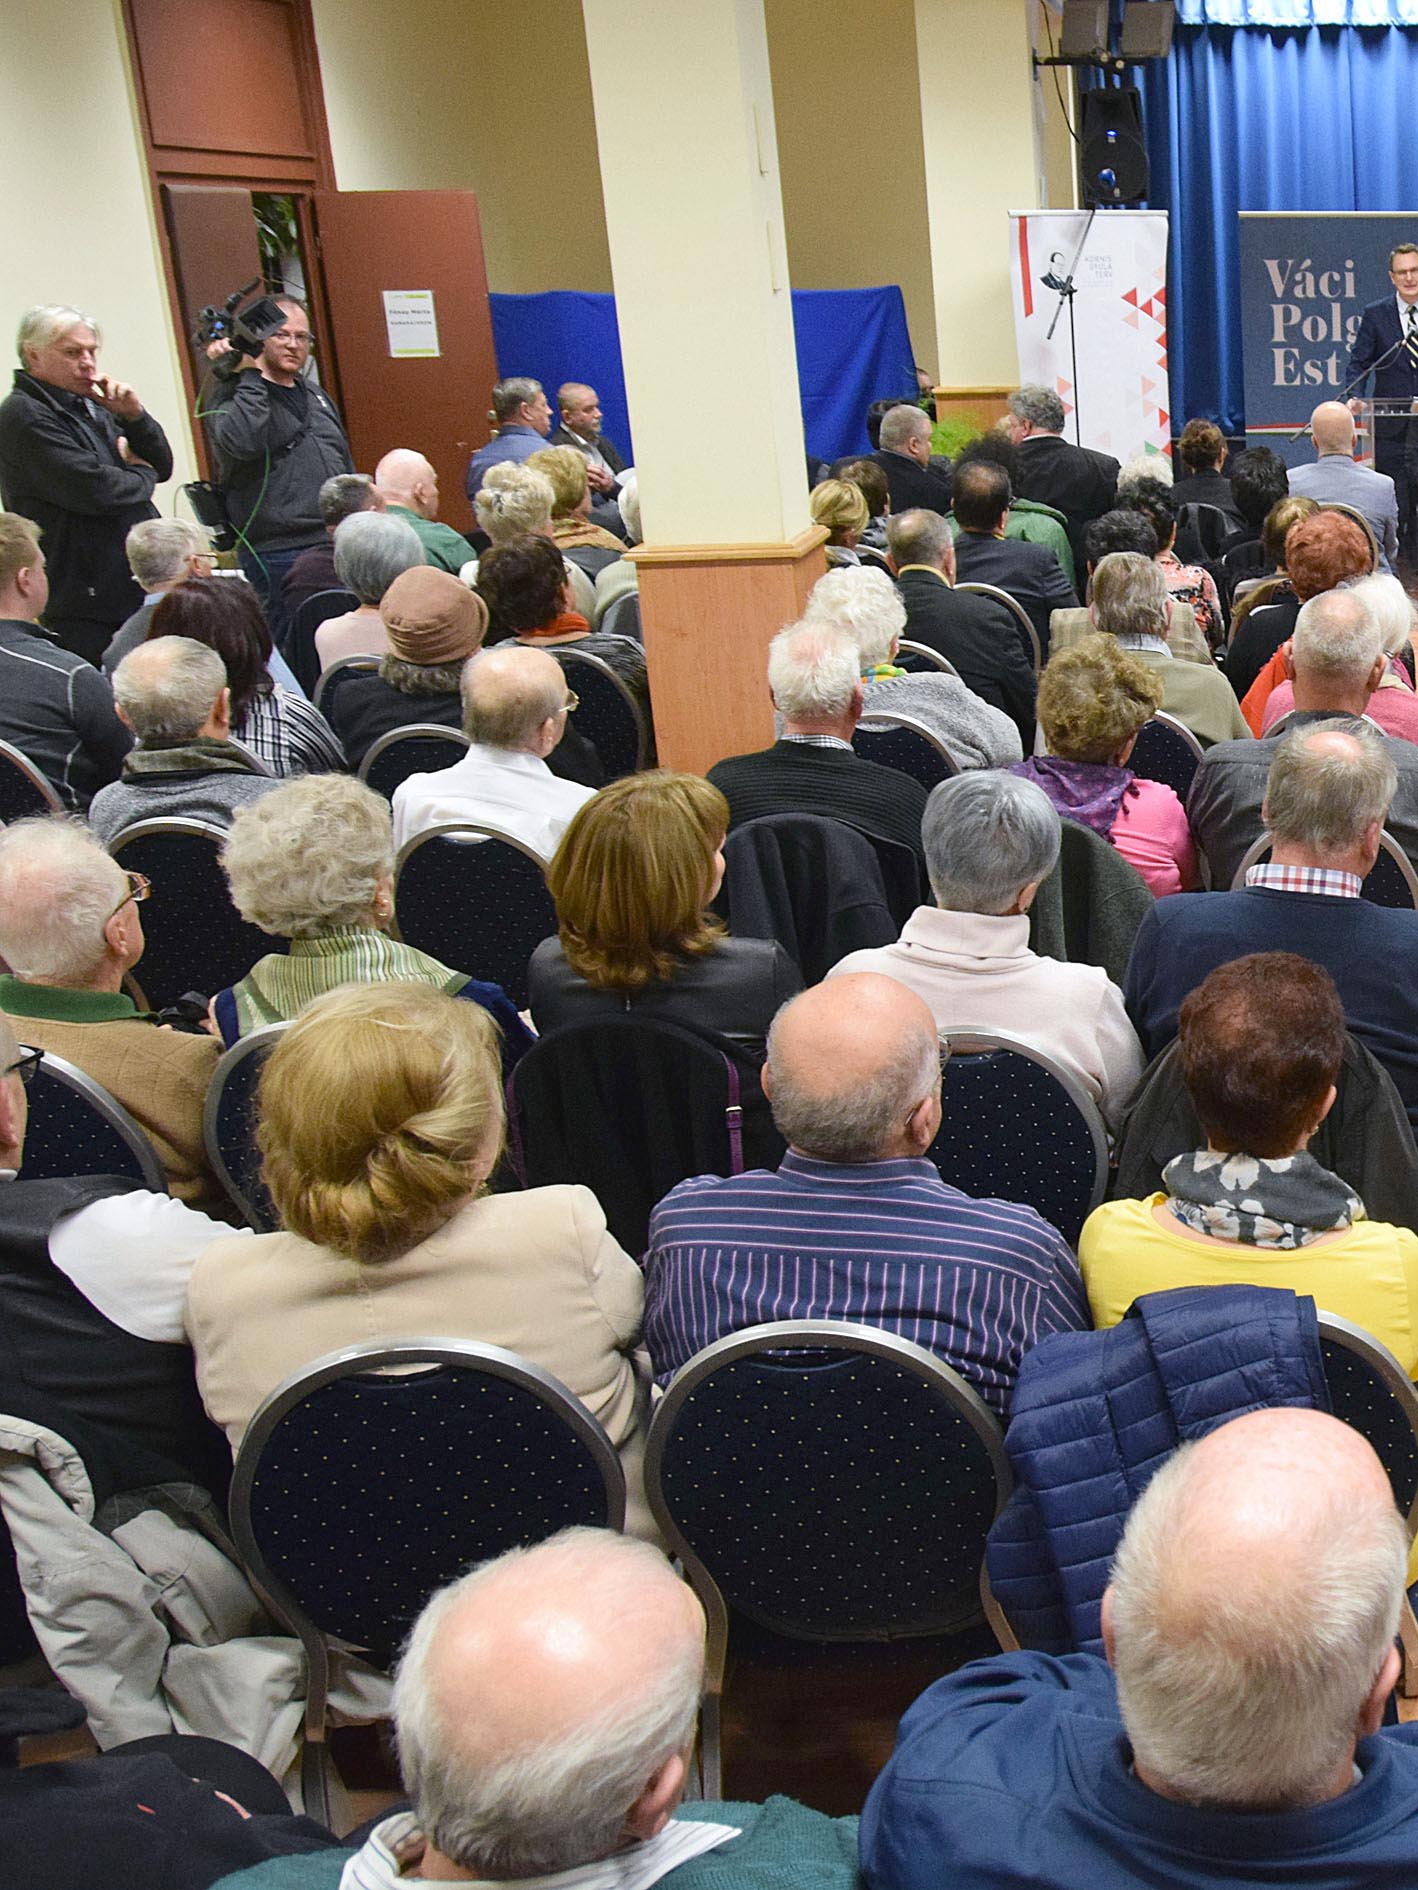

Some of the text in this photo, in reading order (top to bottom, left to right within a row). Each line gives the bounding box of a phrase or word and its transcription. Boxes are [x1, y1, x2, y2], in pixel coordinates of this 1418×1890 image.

[1263, 258, 1356, 298] Váci
[1270, 302, 1362, 352] Polg
[1272, 348, 1342, 386] Est
